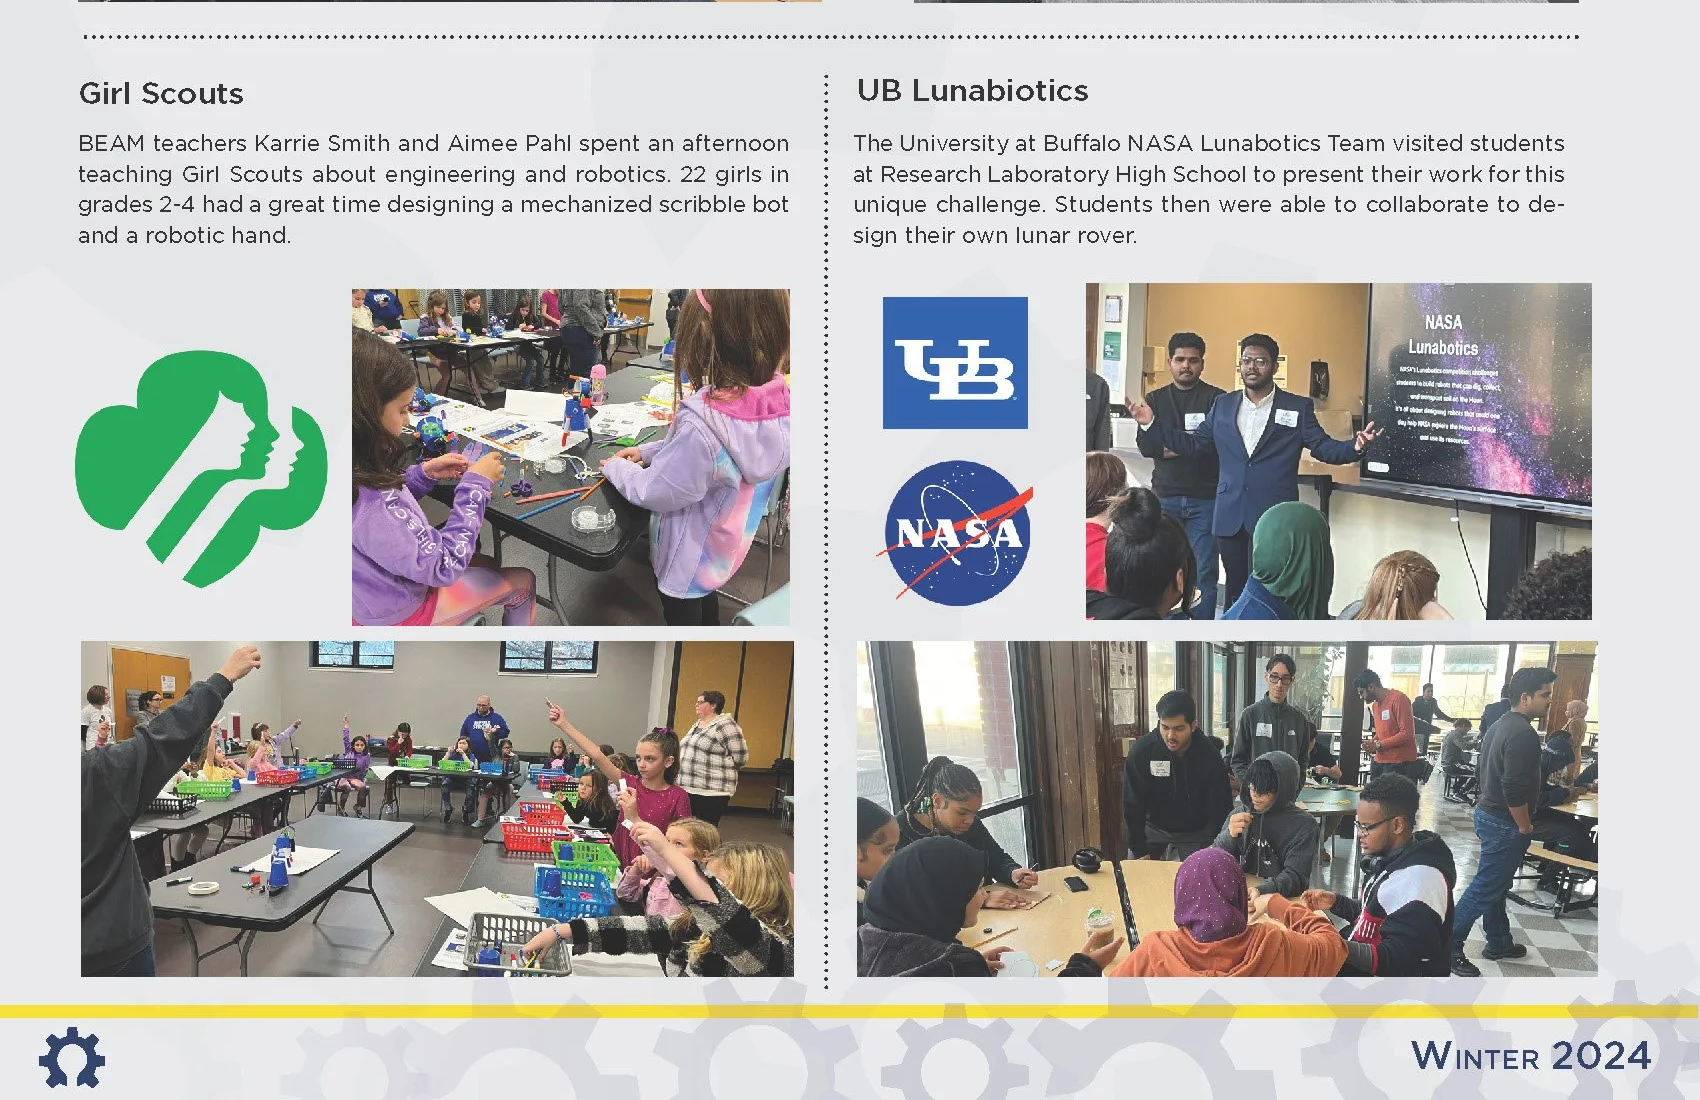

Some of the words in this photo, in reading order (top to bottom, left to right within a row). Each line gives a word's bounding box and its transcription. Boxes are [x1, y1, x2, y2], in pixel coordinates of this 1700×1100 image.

[79, 81, 130, 105] Girl
[141, 81, 244, 105] Scouts
[858, 78, 902, 102] UB
[913, 78, 1089, 102] Lunabiotics
[79, 134, 144, 152] BEAM
[153, 133, 247, 152] teachers
[255, 134, 320, 152] Karrie
[328, 133, 390, 152] Smith
[398, 133, 439, 152] and
[447, 134, 518, 152] Aimee
[526, 133, 571, 152] Pahl
[579, 134, 640, 156] spent
[648, 138, 674, 152] an
[682, 133, 789, 152] afternoon
[853, 133, 893, 152] The
[900, 134, 1010, 156] University
[1015, 134, 1036, 152] at
[1044, 133, 1121, 152] Buffalo
[1128, 134, 1194, 152] NASA
[1201, 133, 1321, 152] Lunabotics
[1327, 134, 1385, 152] Team
[1392, 133, 1463, 152] visited
[1470, 133, 1565, 152] students
[78, 164, 172, 187] teaching
[182, 165, 219, 183] Girl
[230, 165, 303, 183] Scouts
[312, 164, 376, 183] about
[385, 165, 515, 187] engineering
[525, 164, 566, 183] and
[576, 164, 671, 183] robotics.
[680, 165, 706, 183] 22
[715, 165, 762, 187] girls
[771, 165, 789, 183] in
[853, 165, 873, 183] at
[881, 164, 981, 183] Research
[988, 164, 1110, 187] Laboratory
[1116, 164, 1166, 187] High
[1173, 164, 1246, 183] School
[1253, 165, 1276, 183] to
[1283, 165, 1364, 187] present
[1371, 164, 1423, 183] their
[1428, 164, 1483, 183] work
[1488, 164, 1521, 183] for
[1525, 164, 1565, 183] this
[854, 195, 927, 217] unique
[936, 194, 1046, 217] challenge.
[1055, 194, 1153, 213] Students
[1161, 194, 1210, 213] then
[1218, 199, 1272, 213] were
[1280, 194, 1326, 213] able
[1334, 195, 1357, 213] to
[1366, 194, 1489, 213] collaborate
[1497, 195, 1520, 213] to
[1528, 194, 1565, 213] de-
[78, 225, 118, 244] and
[126, 230, 138, 244] a
[146, 225, 225, 244] robotic
[232, 225, 291, 244] hand.
[853, 226, 897, 248] sign
[905, 225, 956, 244] their
[962, 230, 1008, 244] own
[1016, 226, 1071, 244] lunar
[1078, 230, 1137, 244] rover.
[1425, 314, 1463, 330] NASA
[1408, 338, 1479, 356] Lunabotics
[894, 339, 1015, 401] UB
[896, 518, 1024, 549] NASA
[1552, 1040, 1652, 1070] 2024
